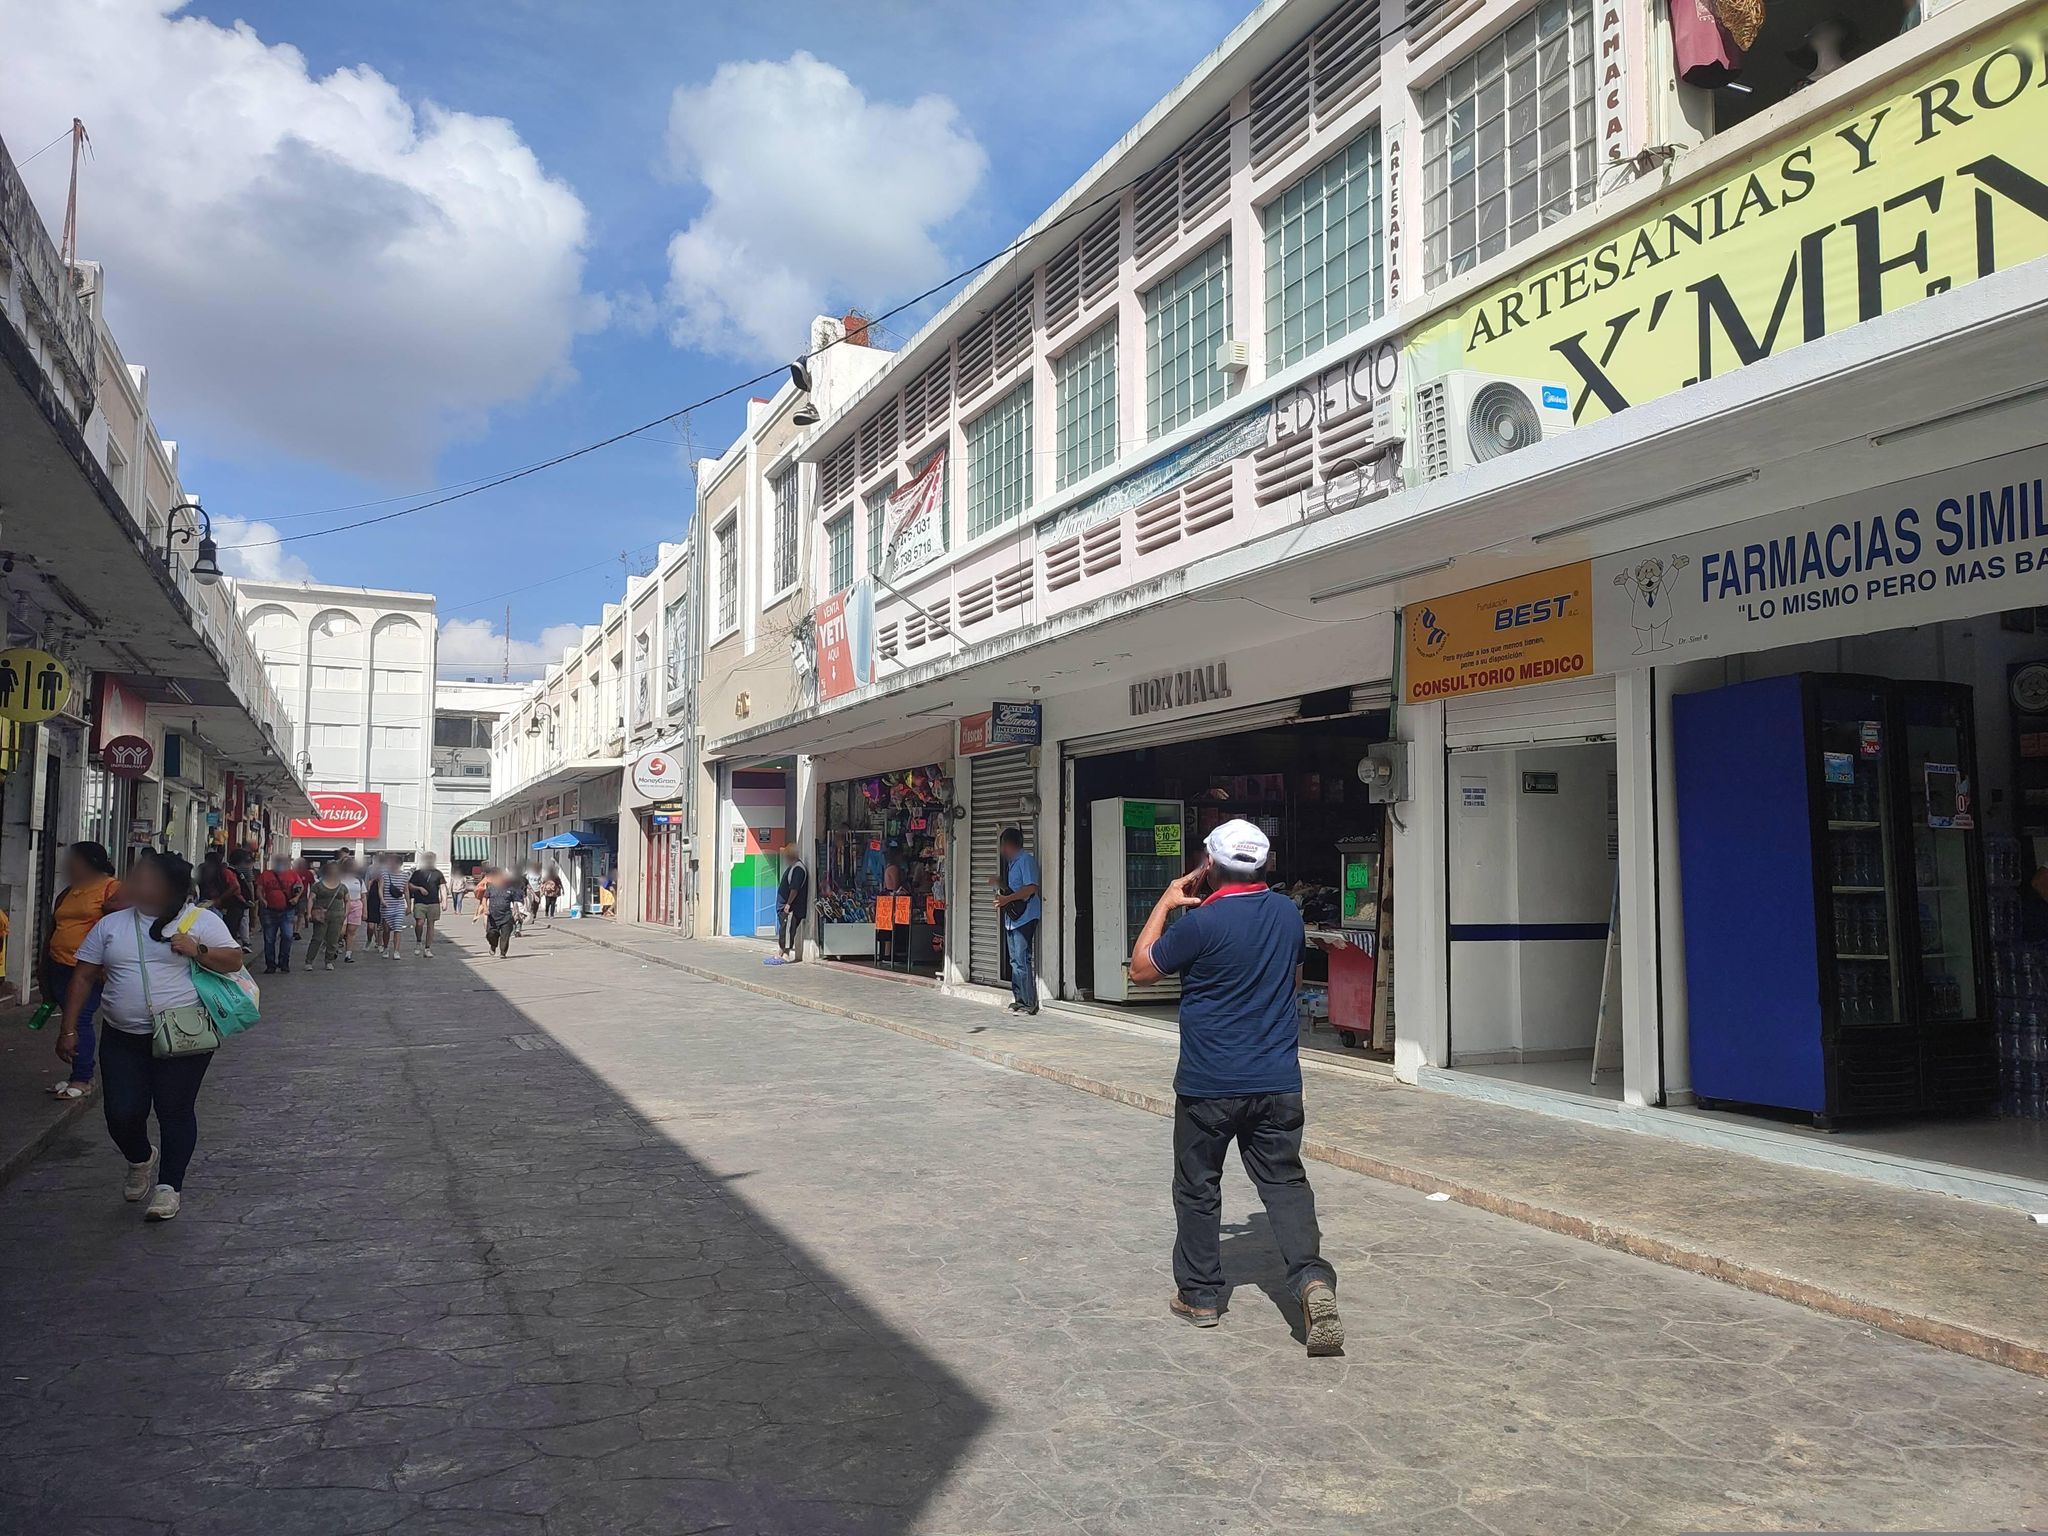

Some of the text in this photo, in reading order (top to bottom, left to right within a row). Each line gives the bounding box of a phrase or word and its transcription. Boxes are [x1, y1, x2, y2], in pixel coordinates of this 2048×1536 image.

[1602, 0, 1623, 161] AMACAS
[1466, 44, 2048, 352] ARTESANIAS Y RO
[1389, 139, 1401, 300] ARTESANIAS
[1701, 478, 2048, 603] FARMACIAS SIMIL
[1738, 600, 1776, 622] "LO
[1782, 583, 1859, 616] MISMO
[1866, 568, 1937, 600] PERO
[1945, 556, 2006, 587] MAS
[823, 600, 841, 619] VENTA
[1494, 594, 1572, 631] BEST
[819, 613, 845, 649] YETI
[1442, 654, 1456, 662] Para
[1455, 650, 1475, 660] ayudar
[1480, 647, 1490, 655] los
[1490, 645, 1502, 654] que
[1502, 641, 1523, 650] menos
[1460, 660, 1475, 670] pone
[1412, 653, 1585, 698] CONSULTORIO MEDICO
[999, 704, 1034, 714] PLATERÍA
[315, 802, 363, 821] risina
